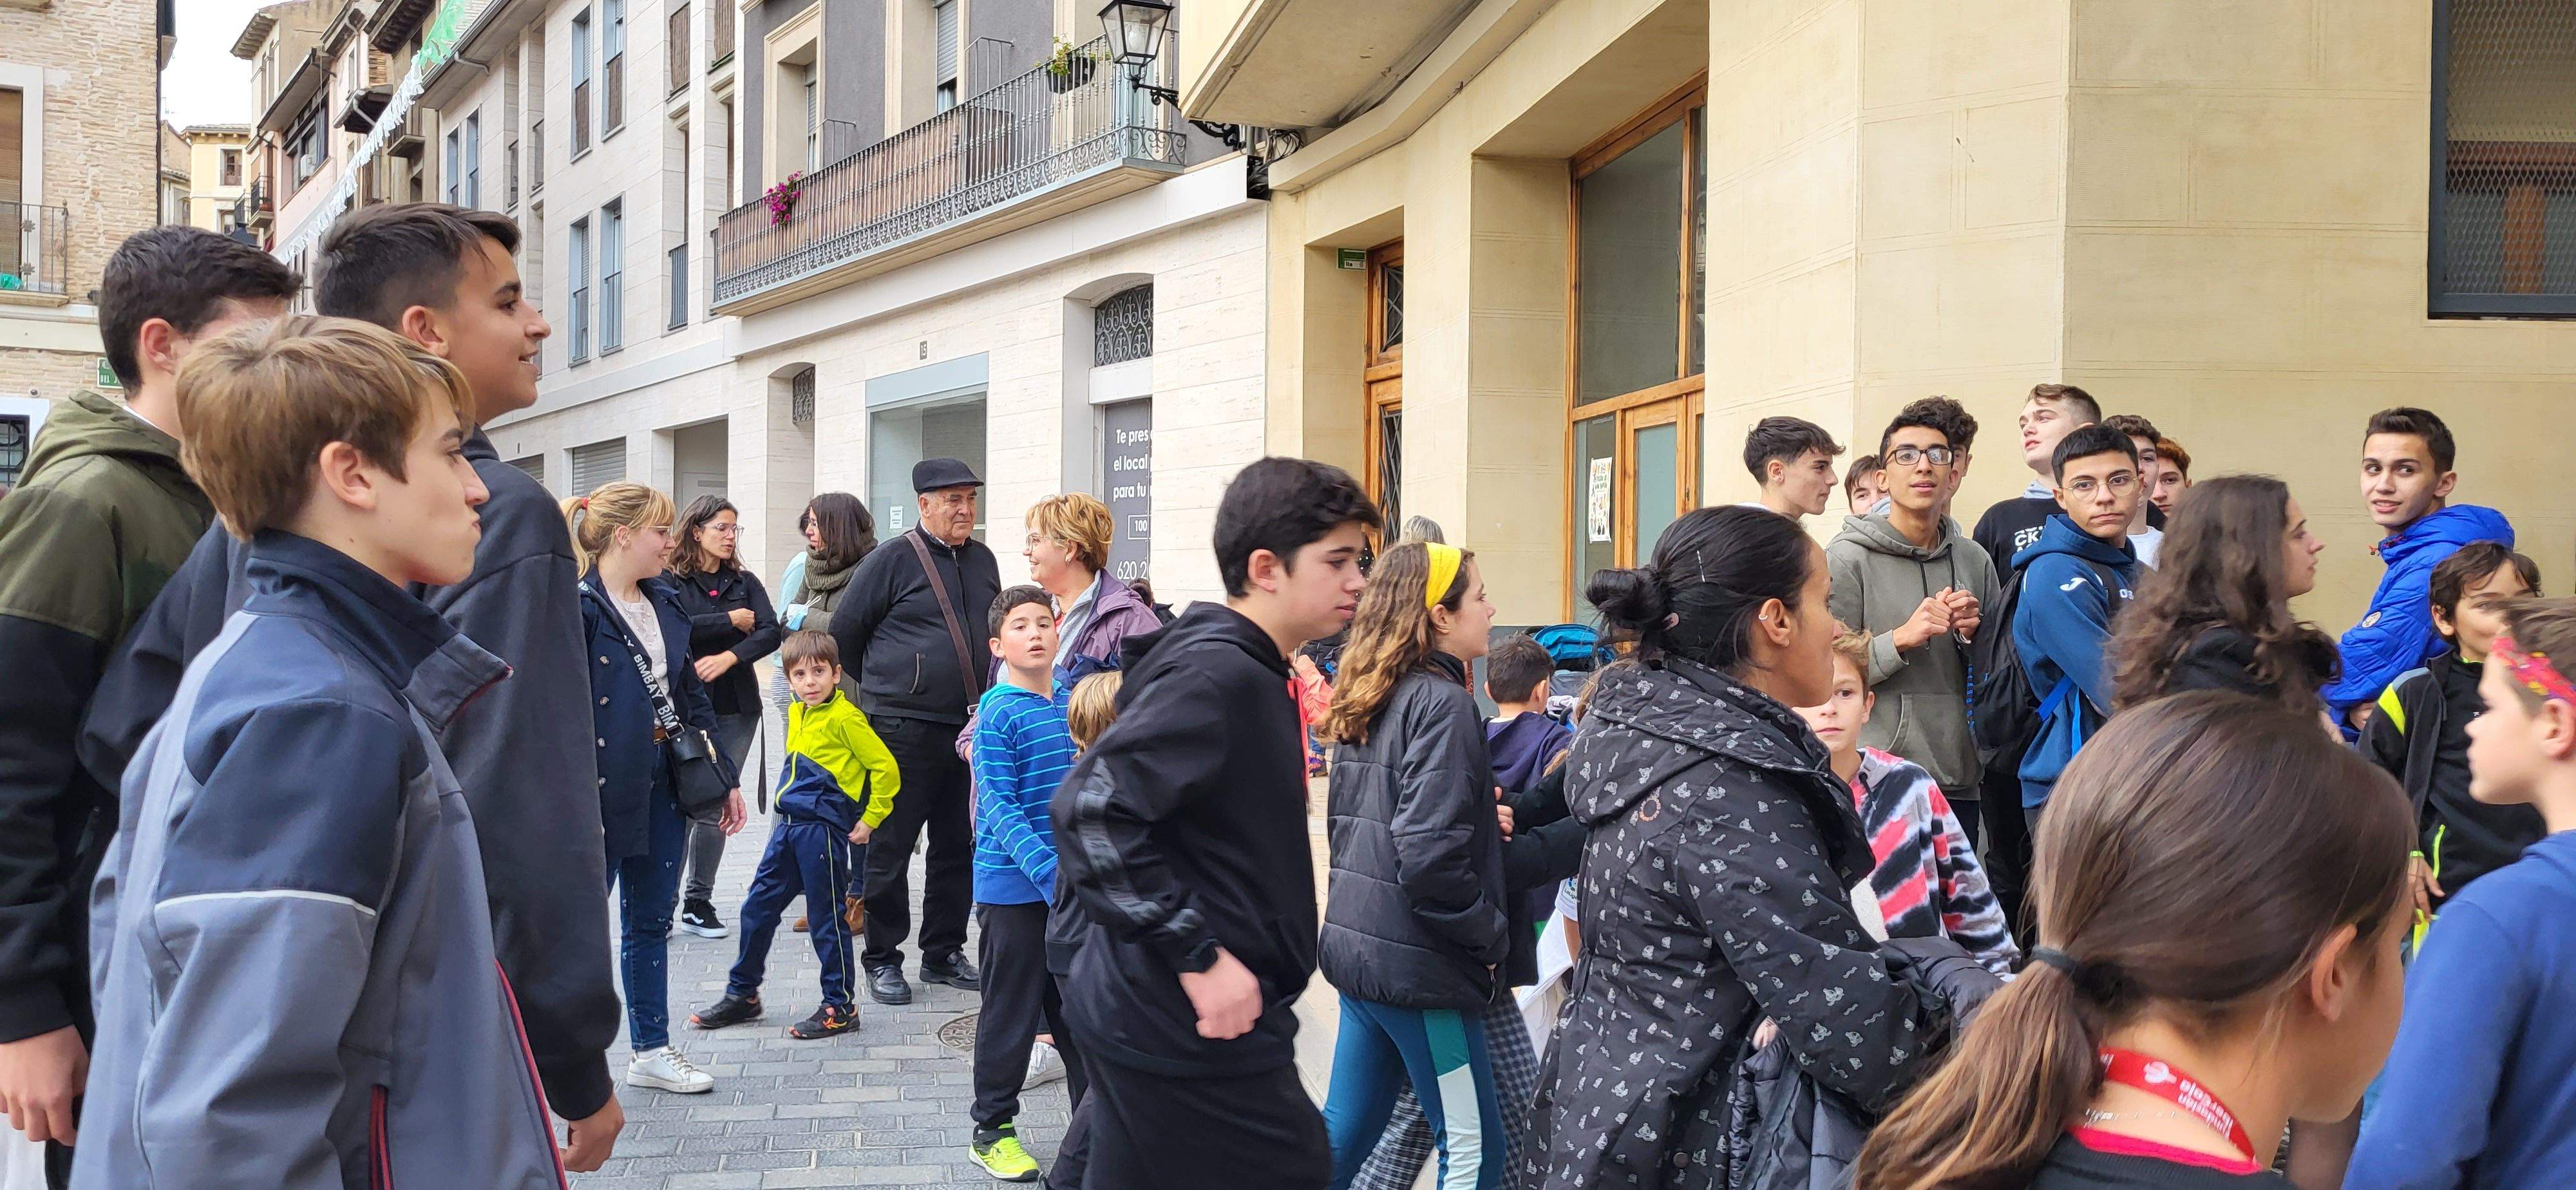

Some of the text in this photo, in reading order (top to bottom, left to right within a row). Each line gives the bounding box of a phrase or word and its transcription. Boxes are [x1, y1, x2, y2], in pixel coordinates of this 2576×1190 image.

[100, 374, 109, 383] DEL
[1116, 429, 1126, 444] Te
[1113, 453, 1148, 471] el local
[1113, 482, 1146, 502] para tu
[1135, 520, 1147, 532] 100
[1117, 560, 1137, 580] 620
[634, 654, 664, 700] BIMBAY
